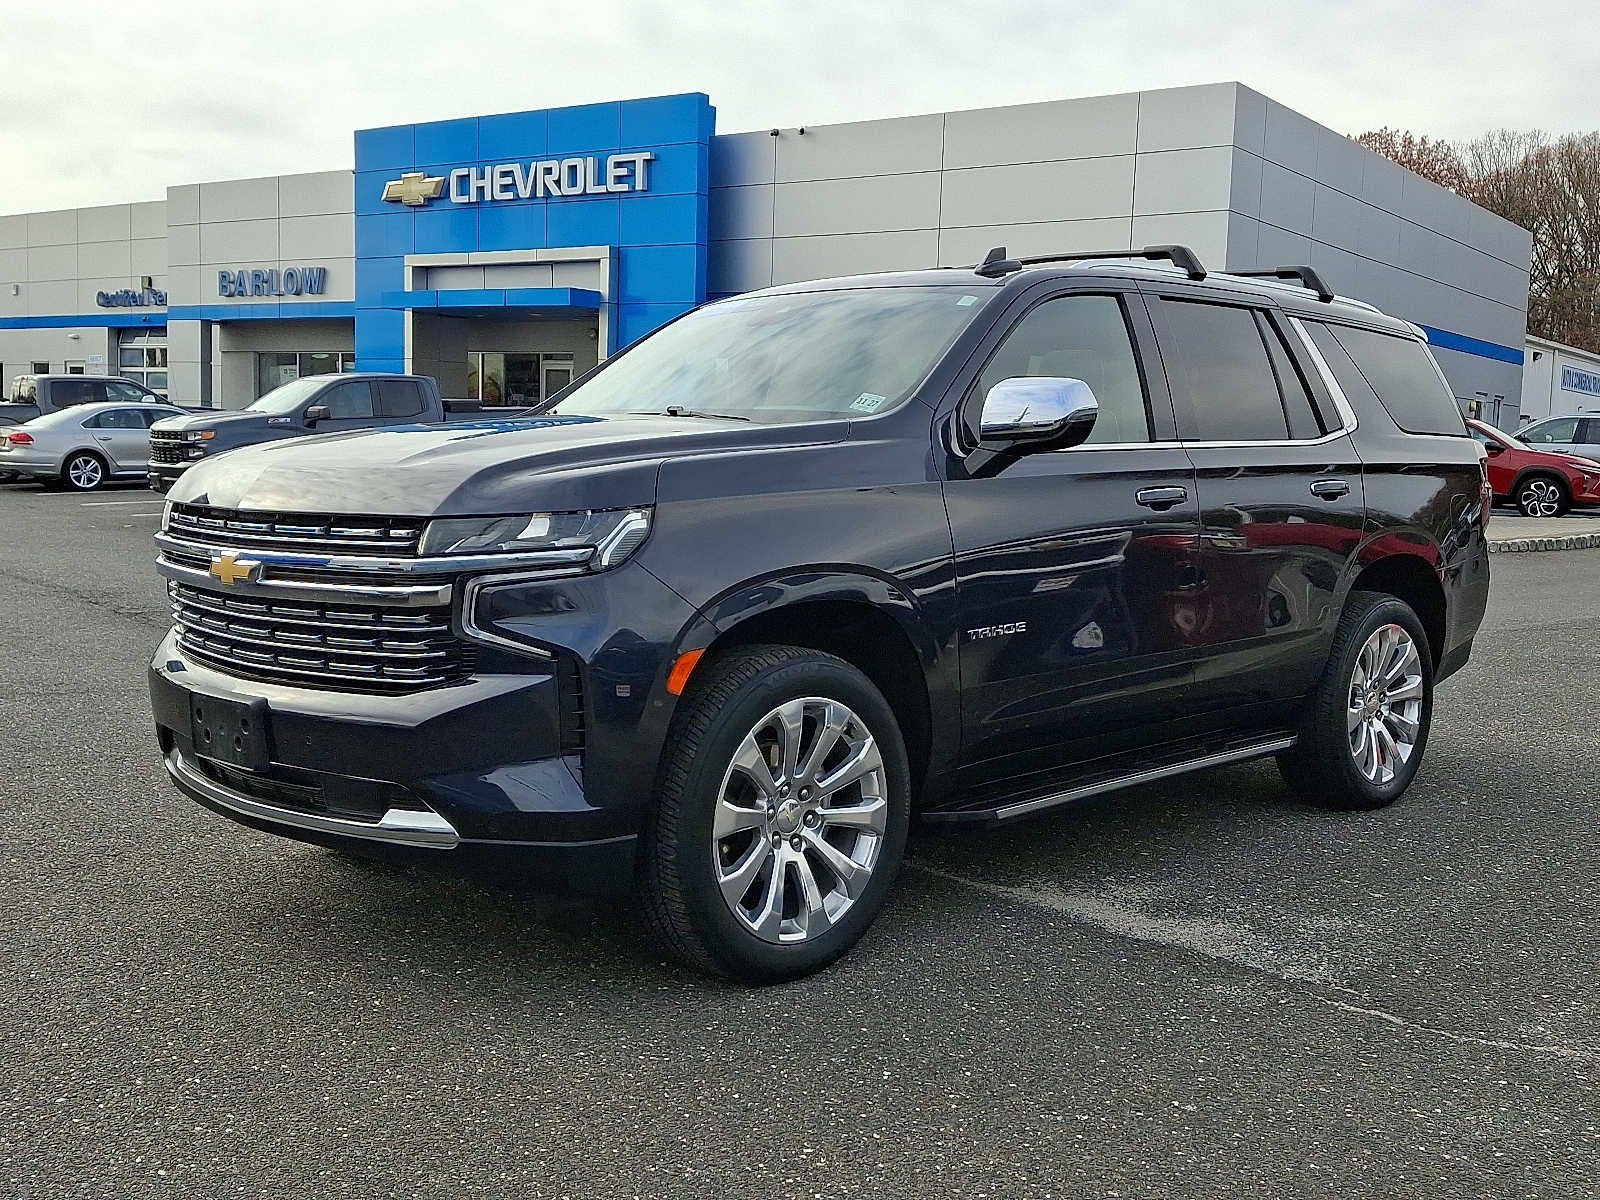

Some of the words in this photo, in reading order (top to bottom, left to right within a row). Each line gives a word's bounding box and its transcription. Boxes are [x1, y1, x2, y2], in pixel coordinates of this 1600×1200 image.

[450, 152, 654, 203] CHEVROLET
[217, 267, 327, 296] BARLOW
[967, 621, 1026, 640] TAHOE
